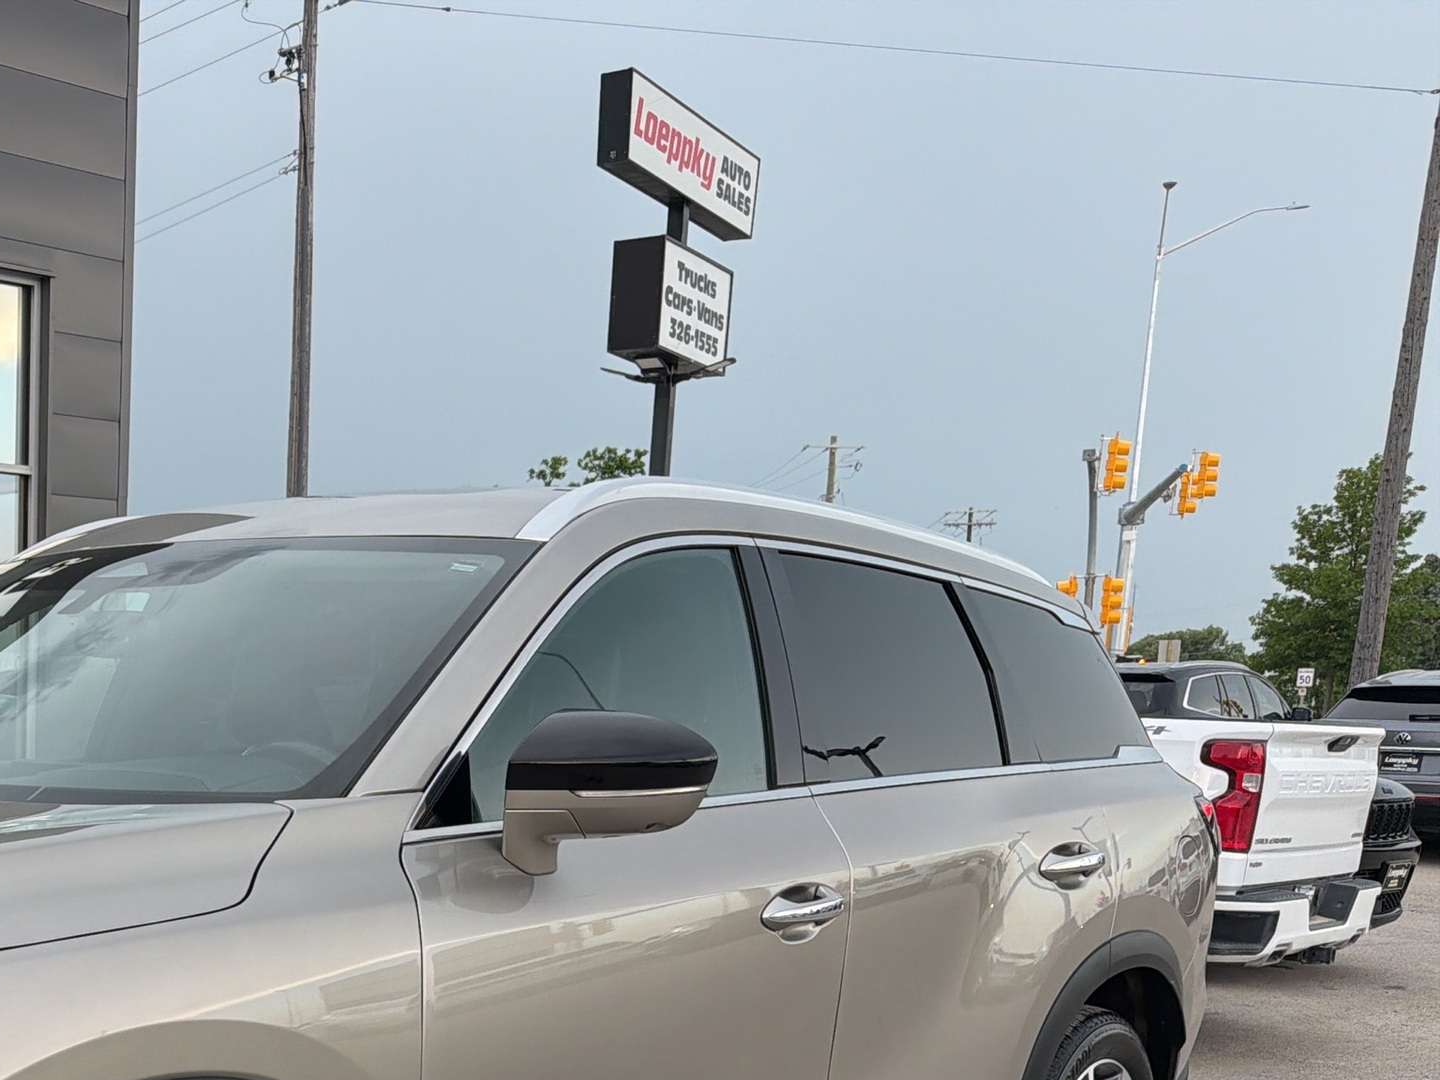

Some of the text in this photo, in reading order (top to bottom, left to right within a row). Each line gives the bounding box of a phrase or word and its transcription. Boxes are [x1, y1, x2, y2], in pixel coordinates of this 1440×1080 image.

[633, 96, 716, 191] Loeppky
[720, 155, 751, 191] AUTO
[716, 178, 751, 216] SALES
[677, 260, 717, 299] Trucks
[1299, 674, 1311, 685] 50
